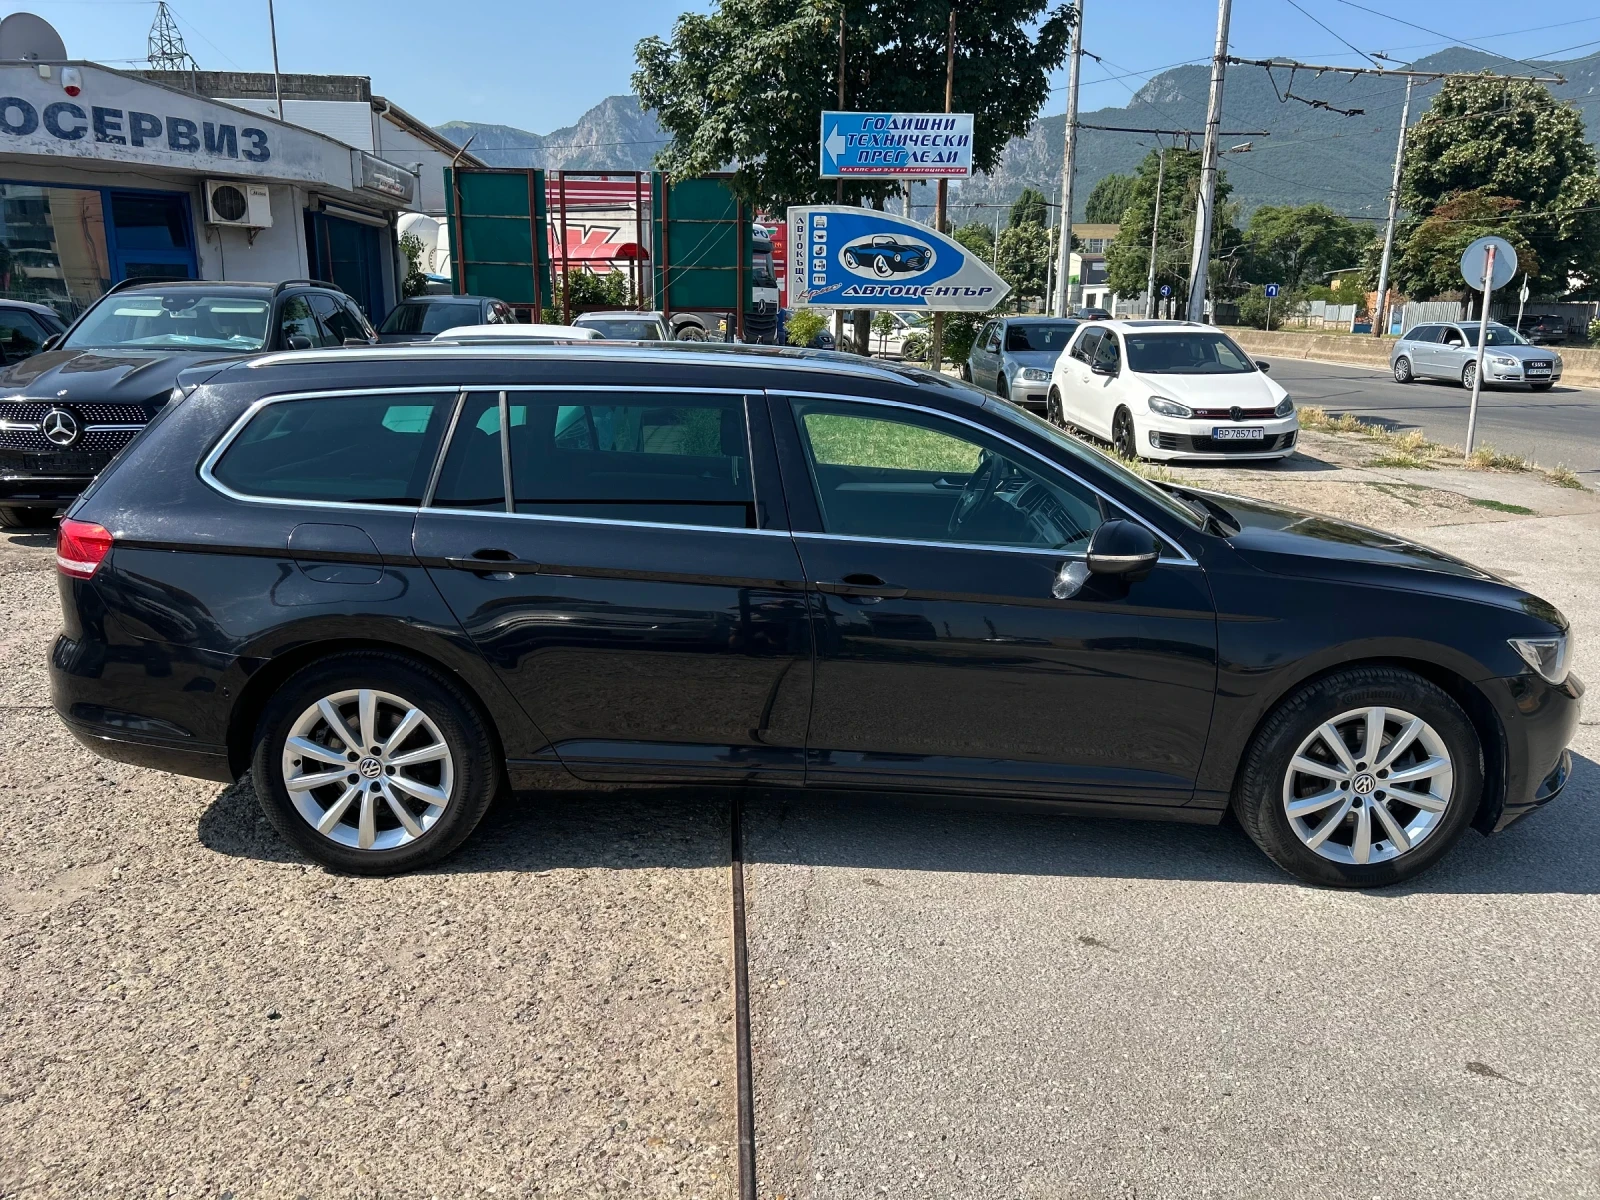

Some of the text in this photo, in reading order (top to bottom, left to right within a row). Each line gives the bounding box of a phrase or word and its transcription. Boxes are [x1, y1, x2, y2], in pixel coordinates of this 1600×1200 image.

[861, 117, 956, 131] ГОДИШНИ
[847, 133, 969, 147] ТЕХНИЧЕСКИ
[857, 150, 958, 163] ПРЕГЛЕДИ
[795, 217, 804, 283] АВТОКЪЩА
[843, 286, 993, 297] АВТОЦЕНТЪР
[1230, 429, 1251, 438] 7857
